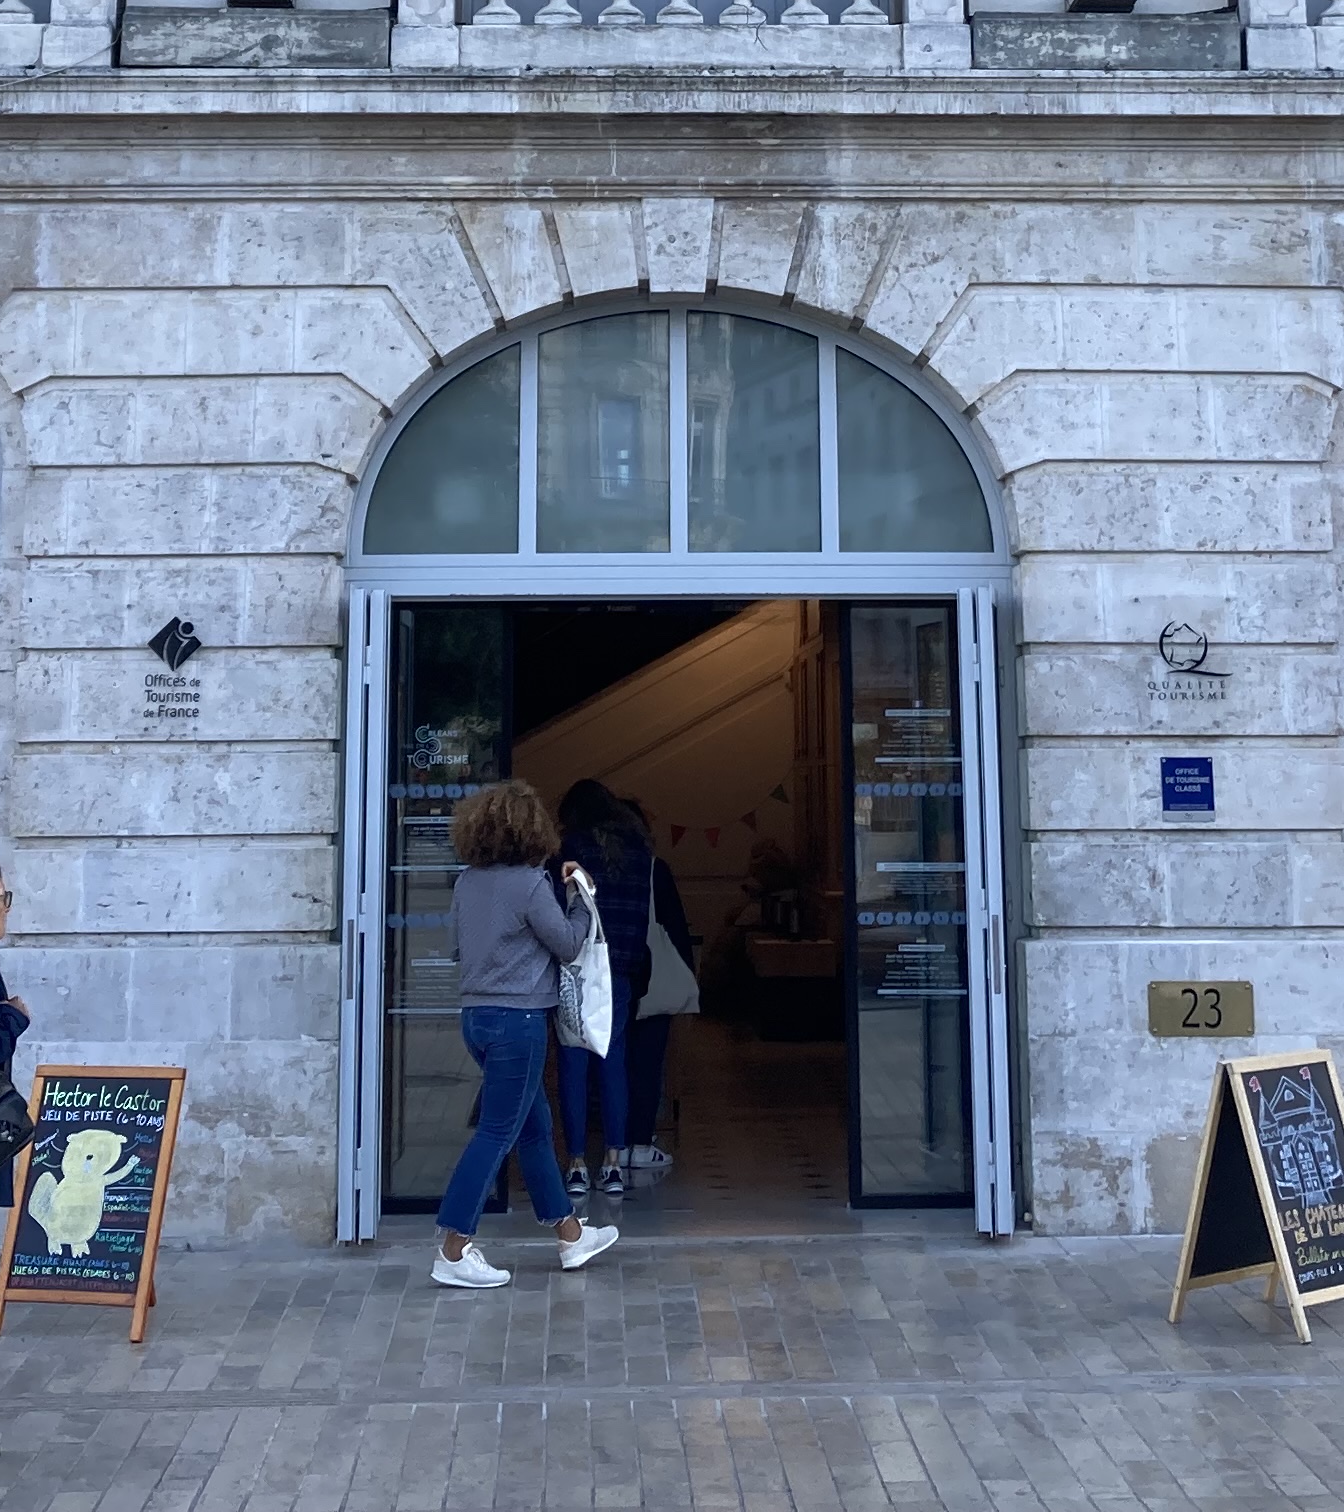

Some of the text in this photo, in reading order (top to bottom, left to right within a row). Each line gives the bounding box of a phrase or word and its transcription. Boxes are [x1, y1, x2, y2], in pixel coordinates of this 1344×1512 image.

[145, 674, 201, 687] Offices de
[144, 689, 201, 703] Tourisme
[1148, 692, 1227, 701] TOURISME
[143, 705, 200, 718] de France
[1181, 988, 1222, 1028] 23
[43, 1081, 166, 1112] Hector le Castor
[40, 1110, 62, 1121] JEU
[65, 1111, 80, 1121] DE
[84, 1110, 114, 1121] PISTE
[1277, 1208, 1301, 1232] LES
[1294, 1226, 1308, 1244] DE
[1309, 1221, 1324, 1238] LA
[12, 1265, 38, 1275] JUEGO
[41, 1266, 52, 1275] DE
